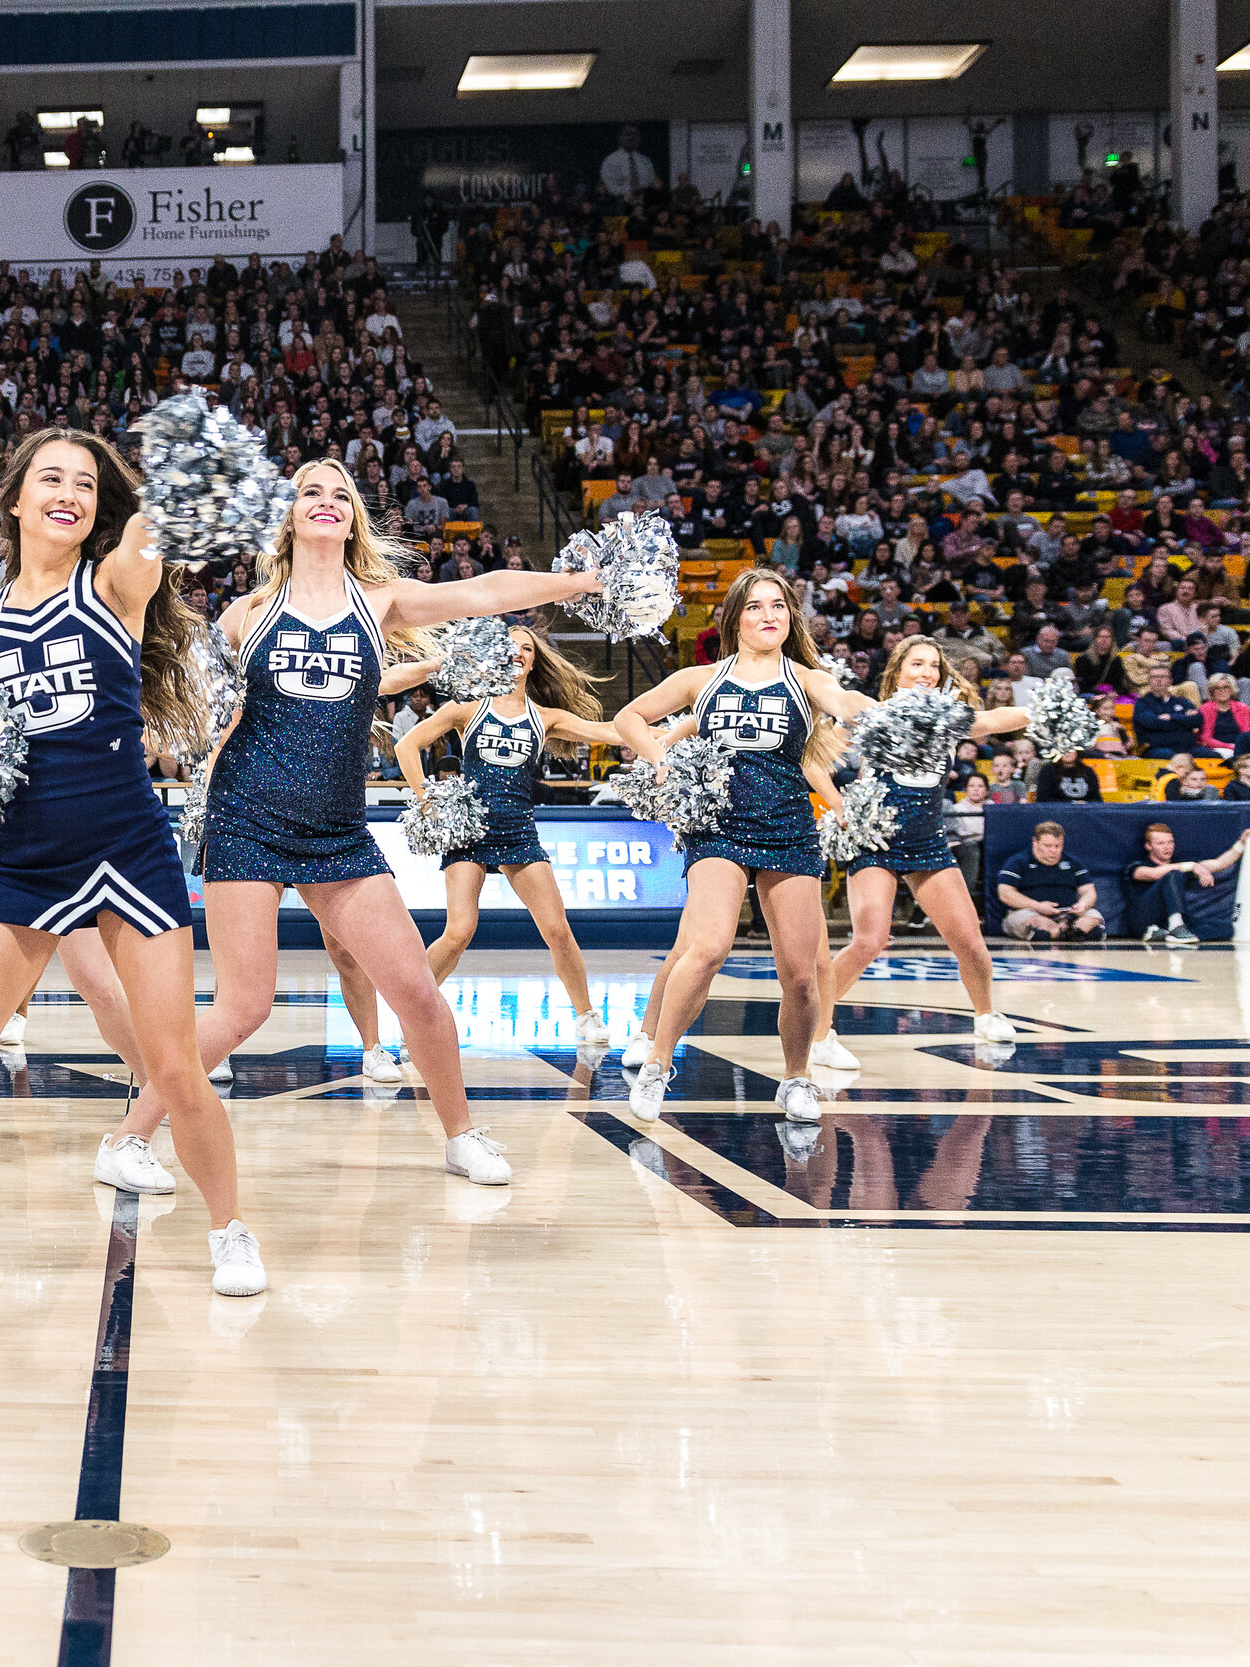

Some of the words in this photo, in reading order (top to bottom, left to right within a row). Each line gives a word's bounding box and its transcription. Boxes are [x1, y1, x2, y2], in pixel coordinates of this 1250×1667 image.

[764, 122, 783, 140] M
[1192, 113, 1209, 130] N
[84, 197, 116, 238] F
[147, 187, 265, 224] Fisher
[142, 227, 186, 241] Home
[189, 225, 271, 242] Furnishings
[268, 650, 363, 680] STATE
[0, 661, 98, 702] TATE
[707, 711, 790, 735] STATE
[476, 734, 533, 757] STATE
[587, 841, 653, 865] FOR
[555, 868, 638, 901] EAR
